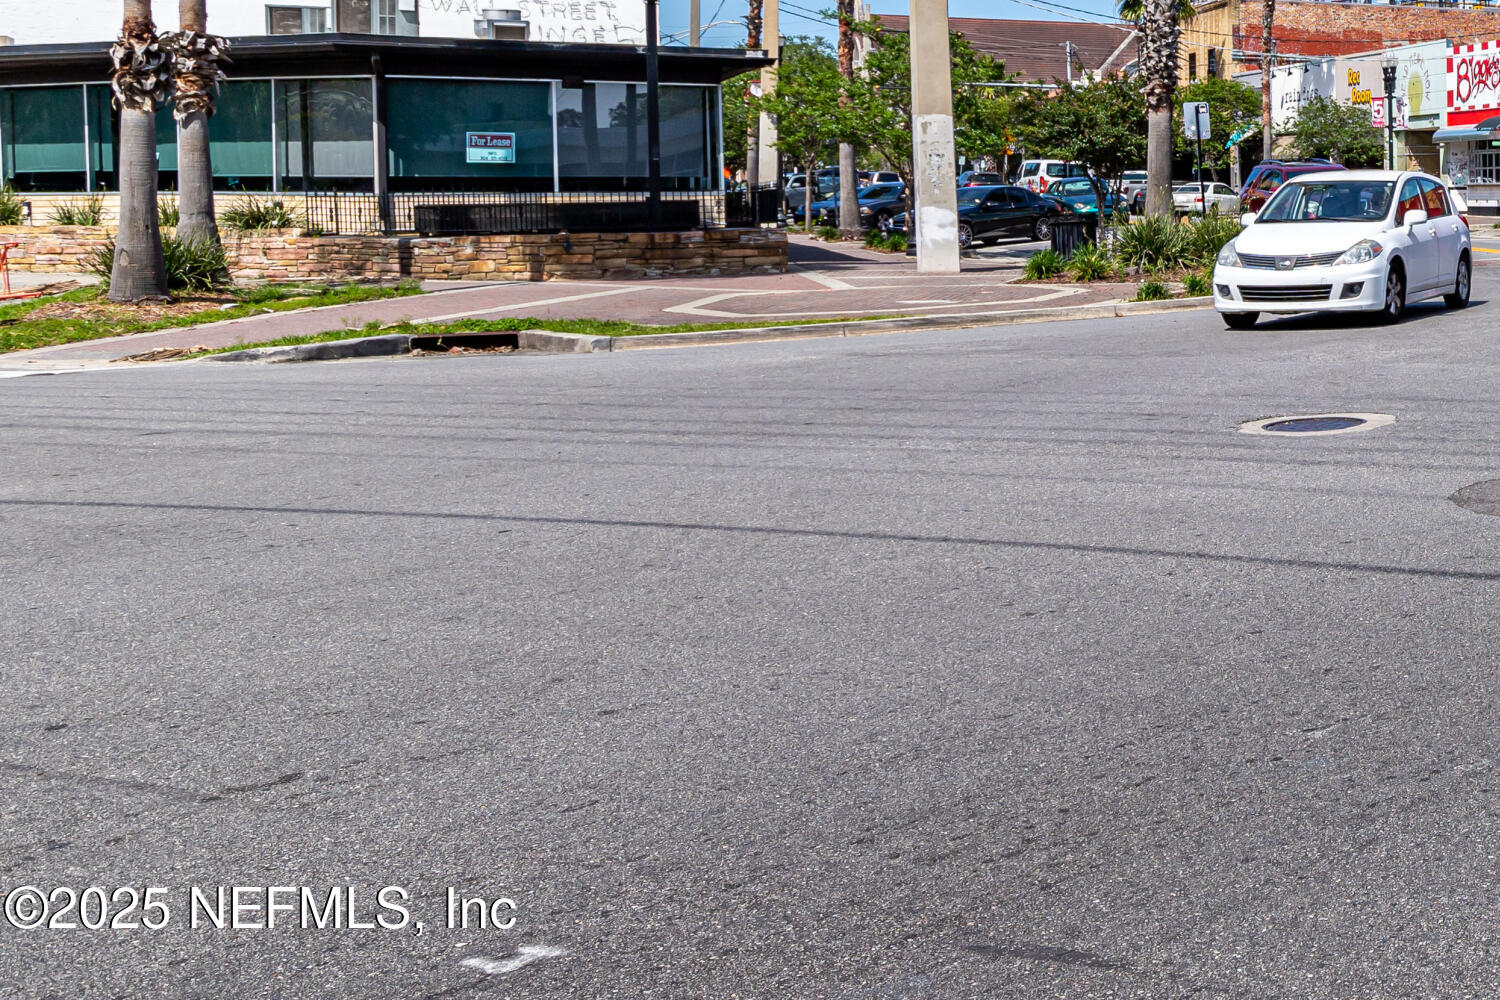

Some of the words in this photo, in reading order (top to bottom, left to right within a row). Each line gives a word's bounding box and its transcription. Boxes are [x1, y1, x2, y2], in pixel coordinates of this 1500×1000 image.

[1347, 67, 1361, 87] Rec
[1351, 87, 1372, 107] Room
[1373, 100, 1384, 119] 5
[471, 135, 486, 146] For
[486, 136, 511, 147] Lease
